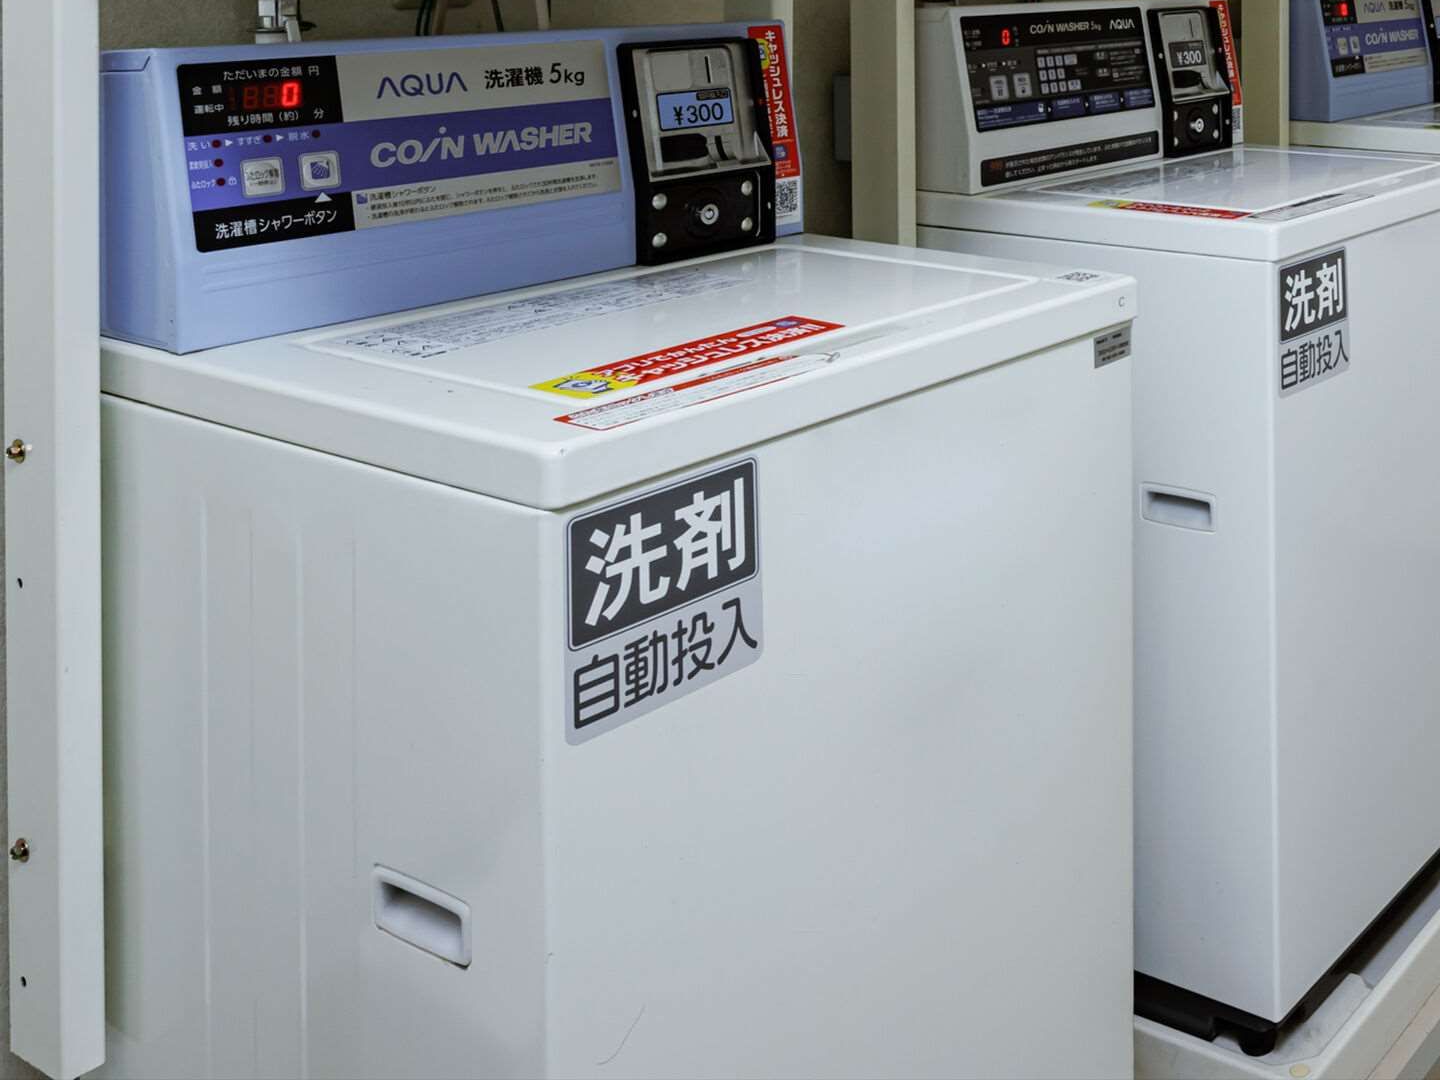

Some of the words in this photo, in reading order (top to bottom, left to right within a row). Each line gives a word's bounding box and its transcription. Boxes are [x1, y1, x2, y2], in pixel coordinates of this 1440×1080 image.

[1029, 20, 1054, 35] COIN
[1055, 21, 1090, 33] WASHER
[1109, 18, 1135, 30] AQUA
[1365, 28, 1388, 46] COIN
[1389, 29, 1420, 43] WASHER
[1176, 50, 1202, 66] ¥300
[223, 66, 303, 81] ただいまの金額
[308, 65, 320, 77] 円
[376, 71, 469, 100] AQUA
[484, 66, 544, 89] 洗濯機
[548, 62, 585, 86] 5kg
[765, 29, 790, 139] キャッシュレス決済
[281, 81, 299, 107] 0
[194, 104, 225, 115] 運転中
[313, 108, 324, 120] 分
[673, 102, 724, 126] ¥300
[370, 125, 465, 169] COIN
[473, 121, 594, 157] WASHER
[215, 209, 338, 240] 洗濯槽シャワーボタン
[1284, 258, 1345, 332] 洗剤
[1281, 329, 1349, 392] 自動投入
[584, 476, 745, 628] 洗剤
[573, 597, 758, 731] 自動投入
